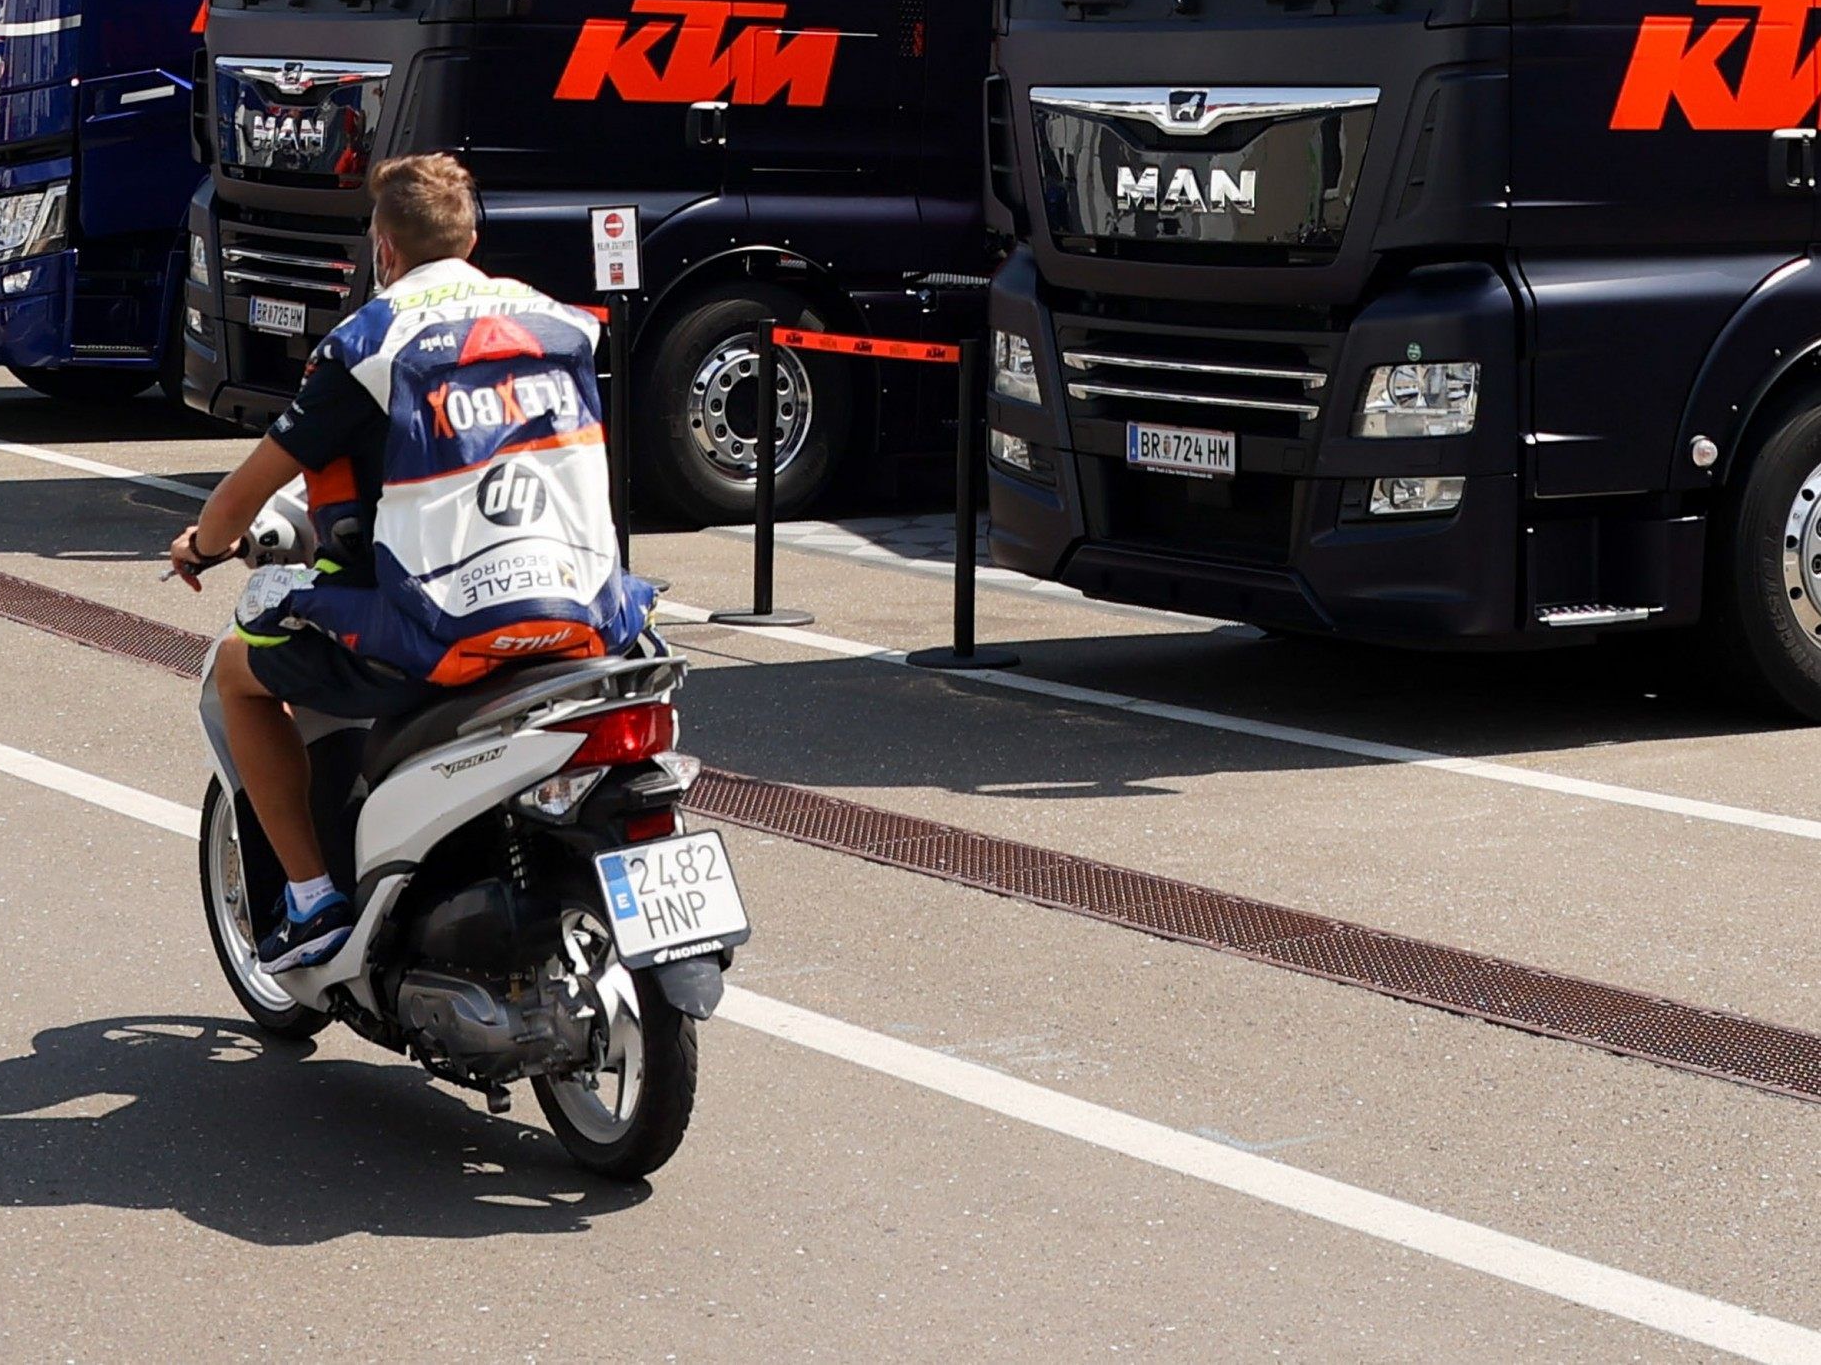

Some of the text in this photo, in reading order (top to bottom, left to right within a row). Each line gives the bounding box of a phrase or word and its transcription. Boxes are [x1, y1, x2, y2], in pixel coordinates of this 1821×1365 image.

[1116, 166, 1257, 215] MAN
[427, 369, 580, 440] FLEXBOX
[1140, 431, 1230, 468] BR 724 HM
[483, 462, 540, 527] hp
[459, 554, 551, 583] SEGUROS
[463, 569, 552, 608] REALE
[490, 627, 573, 652] STIHL
[430, 743, 509, 780] VISION
[630, 844, 724, 896] 2482
[615, 892, 631, 910] E
[641, 890, 707, 940] HNP
[668, 940, 725, 961] HONDA
